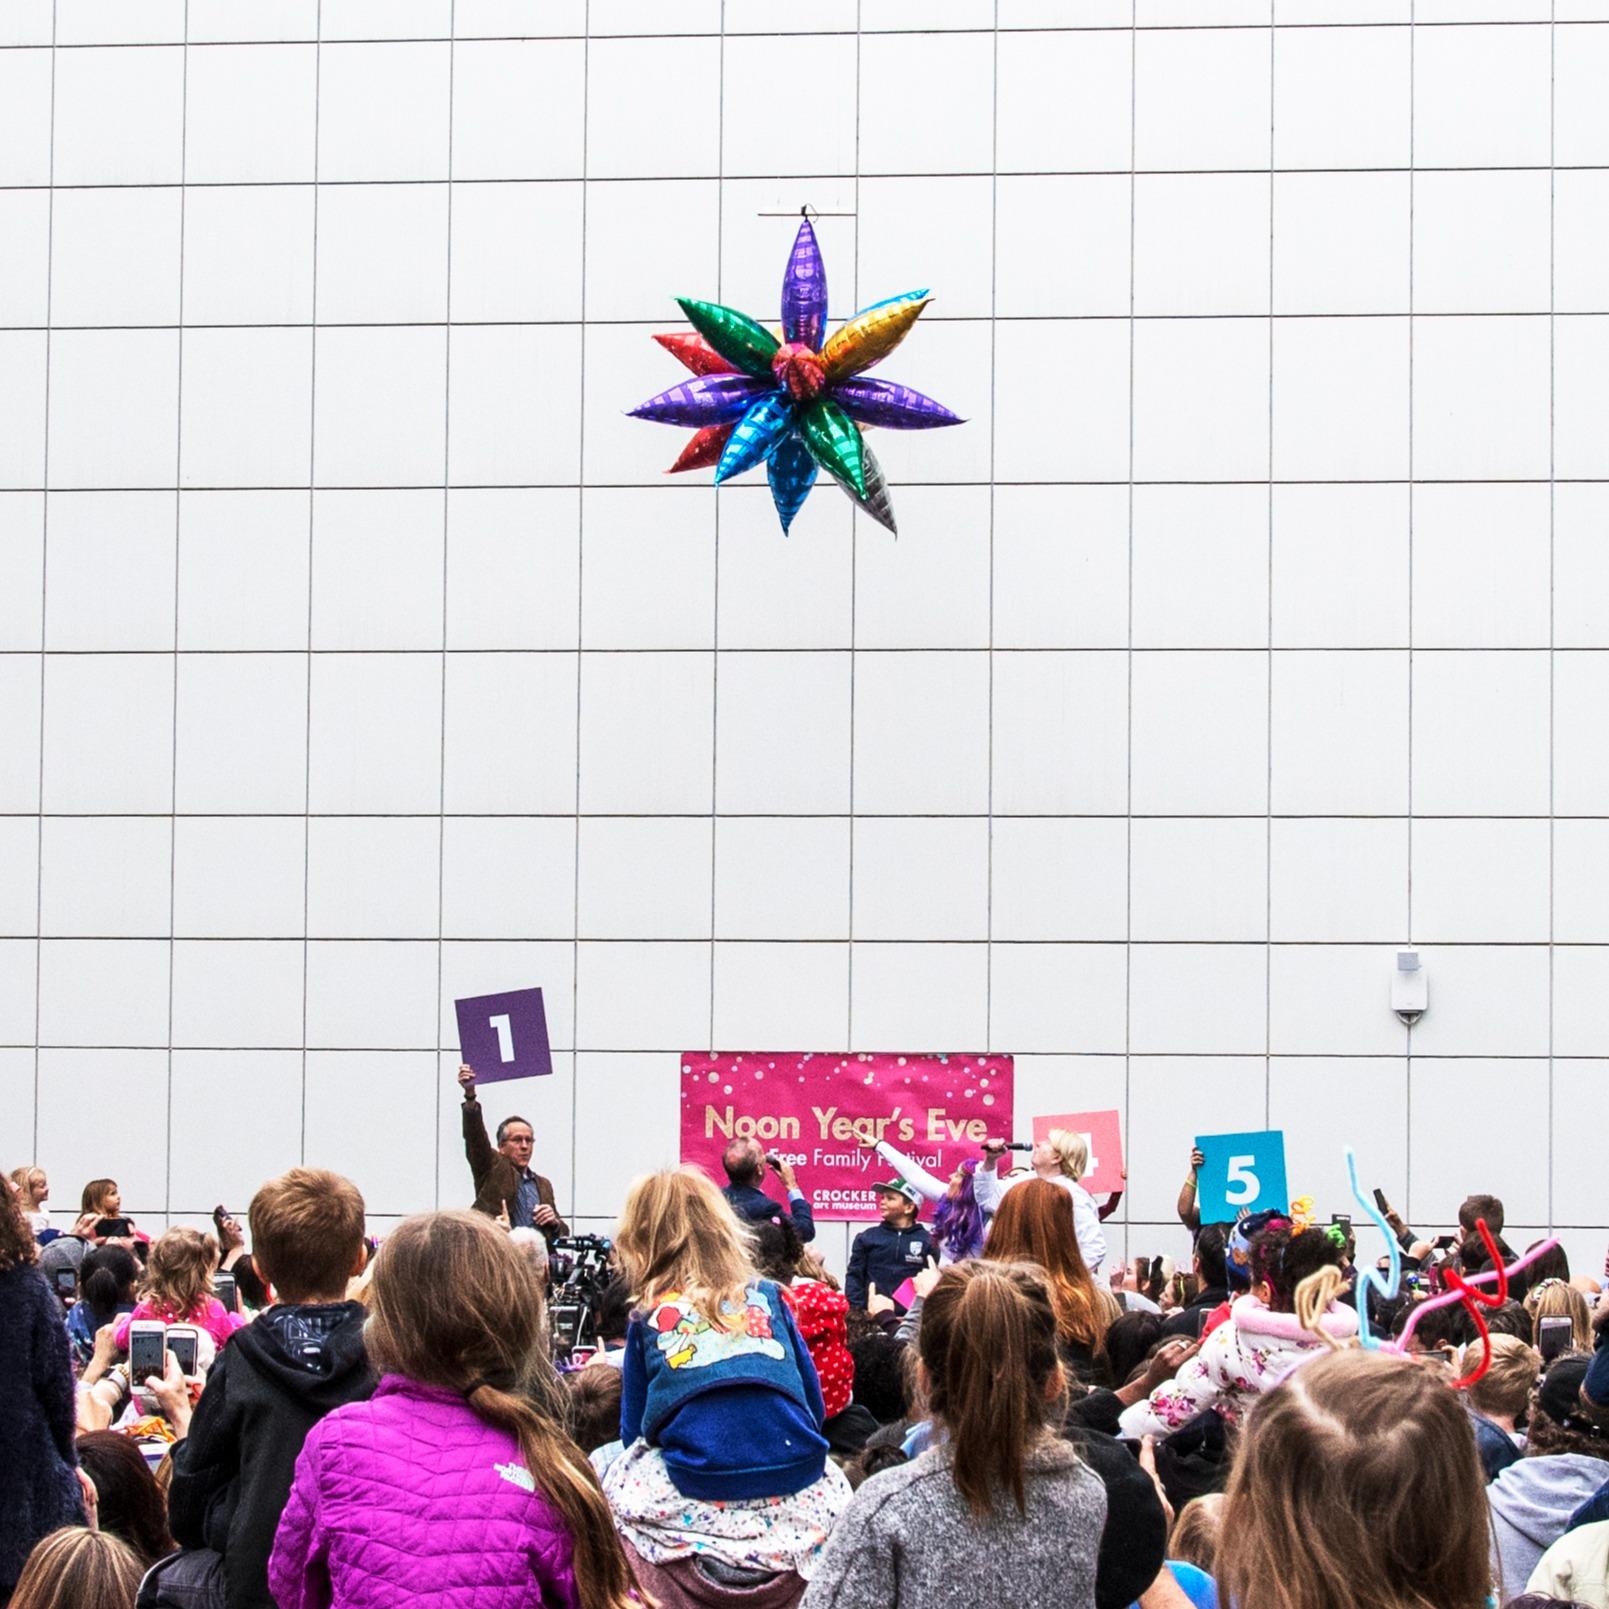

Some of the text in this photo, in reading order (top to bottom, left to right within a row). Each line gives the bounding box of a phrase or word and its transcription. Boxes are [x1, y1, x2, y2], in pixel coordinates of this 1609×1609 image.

[489, 1014, 515, 1062] 1
[705, 1105, 988, 1142] Noon Year's Eve
[814, 1148, 871, 1172] Family
[1225, 1155, 1261, 1206] 5
[813, 1190, 877, 1202] CROCKER
[813, 1202, 877, 1211] art museum
